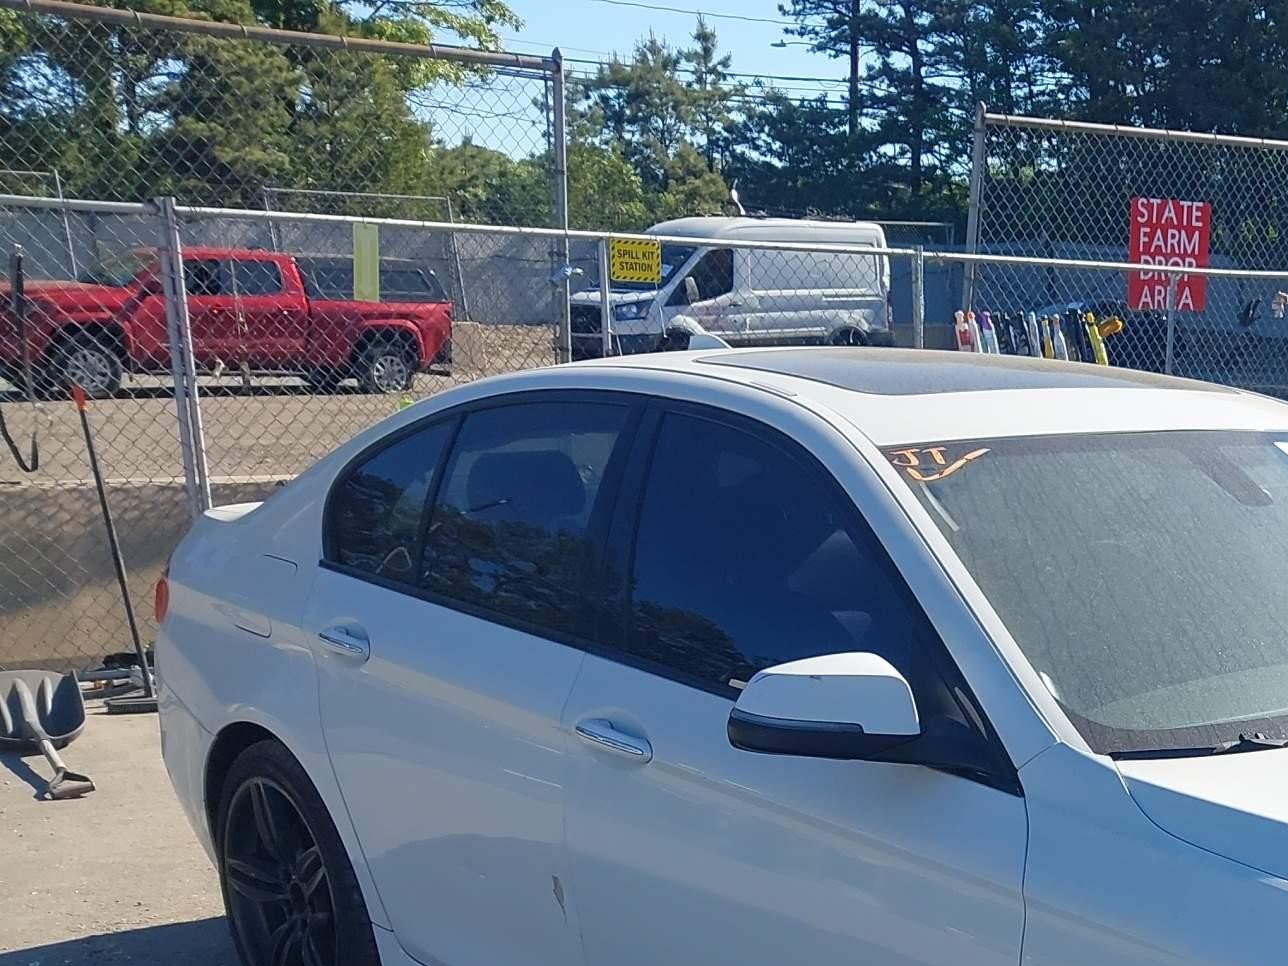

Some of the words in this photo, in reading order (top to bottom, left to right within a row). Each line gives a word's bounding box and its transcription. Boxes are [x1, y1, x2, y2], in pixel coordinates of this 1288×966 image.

[1136, 198, 1203, 227] STATE
[1139, 227, 1200, 255] FARM
[617, 248, 640, 260] SPILL
[642, 250, 655, 261] KIT
[619, 261, 653, 273] STATION
